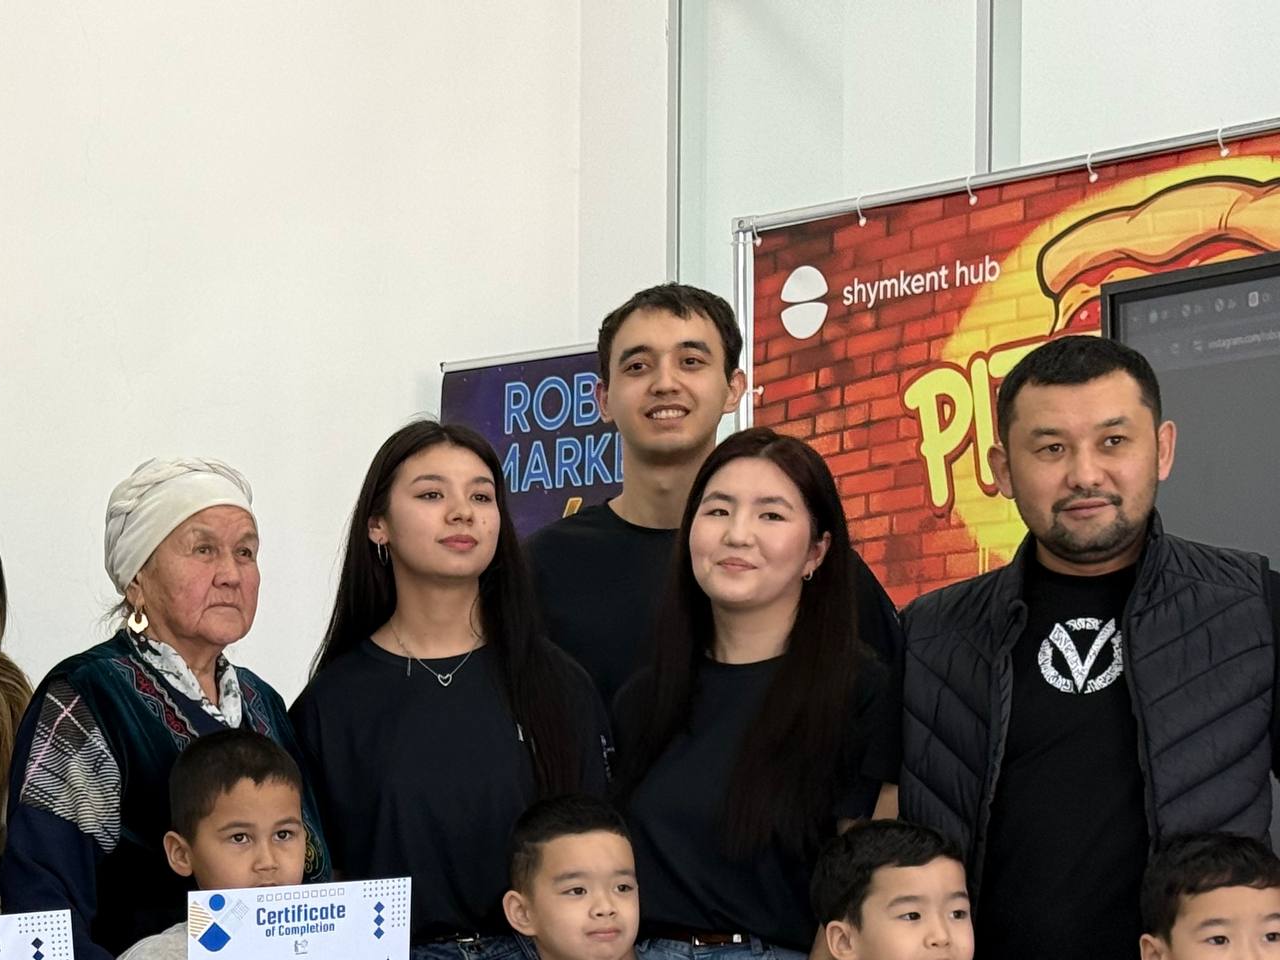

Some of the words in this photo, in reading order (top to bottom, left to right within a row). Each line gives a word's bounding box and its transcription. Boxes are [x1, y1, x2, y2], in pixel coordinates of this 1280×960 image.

[842, 265, 949, 309] shymkent
[955, 255, 1001, 287] hub
[902, 342, 1038, 510] PI
[256, 903, 347, 926] Certificate
[265, 926, 276, 938] of
[278, 921, 336, 937] Completion
